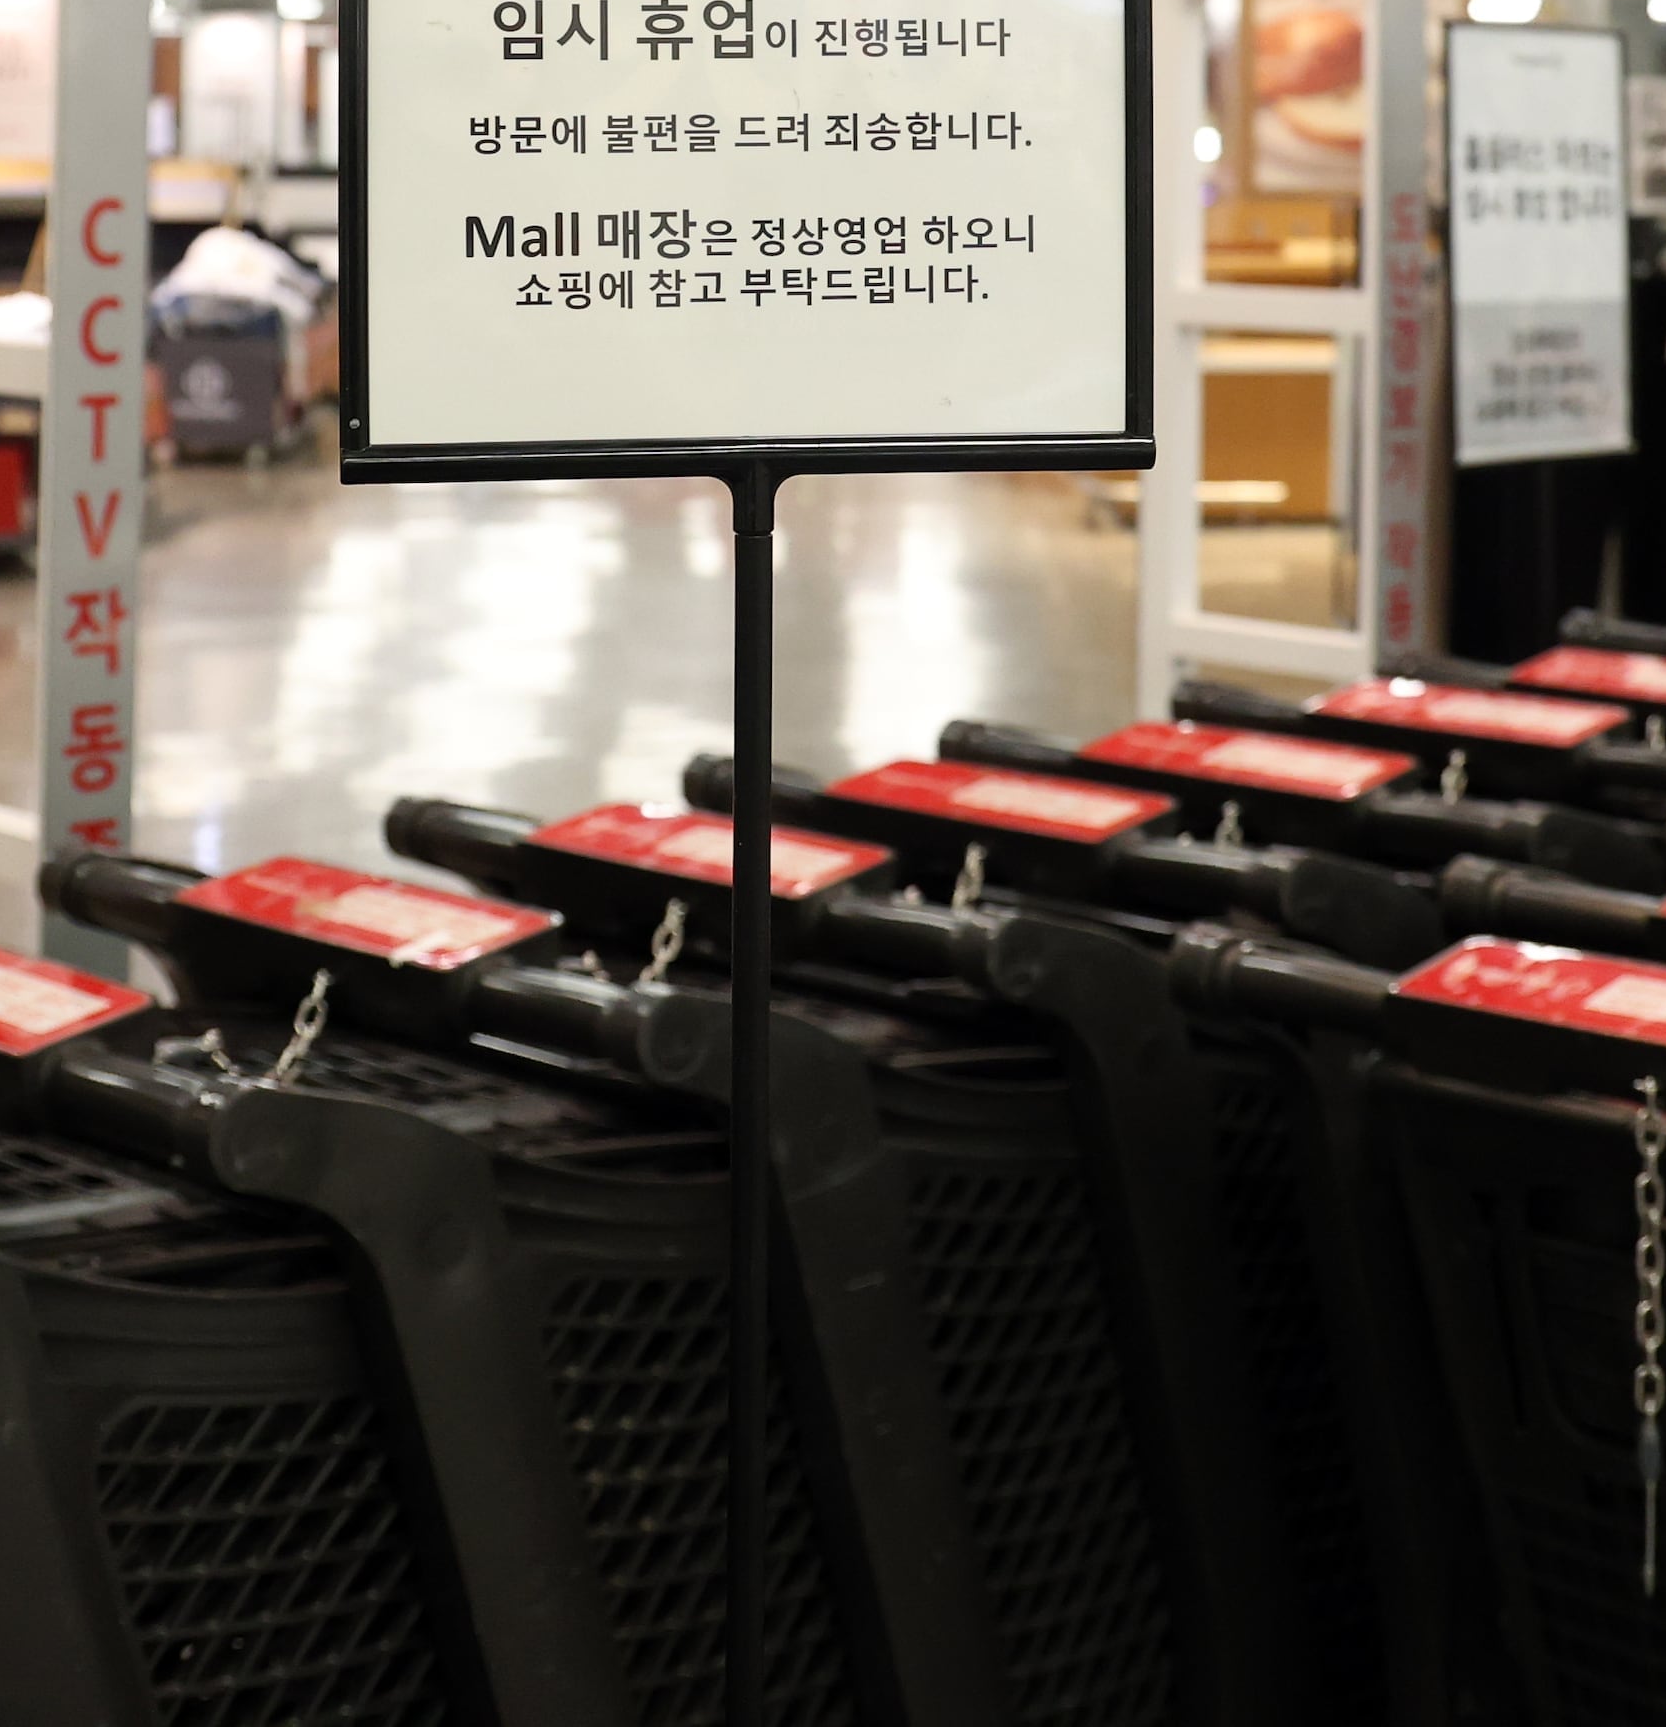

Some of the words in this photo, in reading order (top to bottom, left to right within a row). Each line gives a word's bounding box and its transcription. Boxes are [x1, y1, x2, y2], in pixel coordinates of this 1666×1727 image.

[814, 18, 1012, 58] 진행됩니다
[468, 114, 587, 155] 방문에
[601, 113, 722, 154] 불편을
[733, 112, 811, 153] 드려
[823, 111, 1033, 153] 죄송합니다.
[464, 210, 581, 260] Mall
[596, 208, 739, 261] 매장은
[750, 214, 908, 258] 정상영업
[922, 214, 1035, 254] 하오니
[514, 269, 635, 311] 쇼핑에
[648, 267, 728, 308] 참고
[739, 263, 990, 308] 부탁드립니다.
